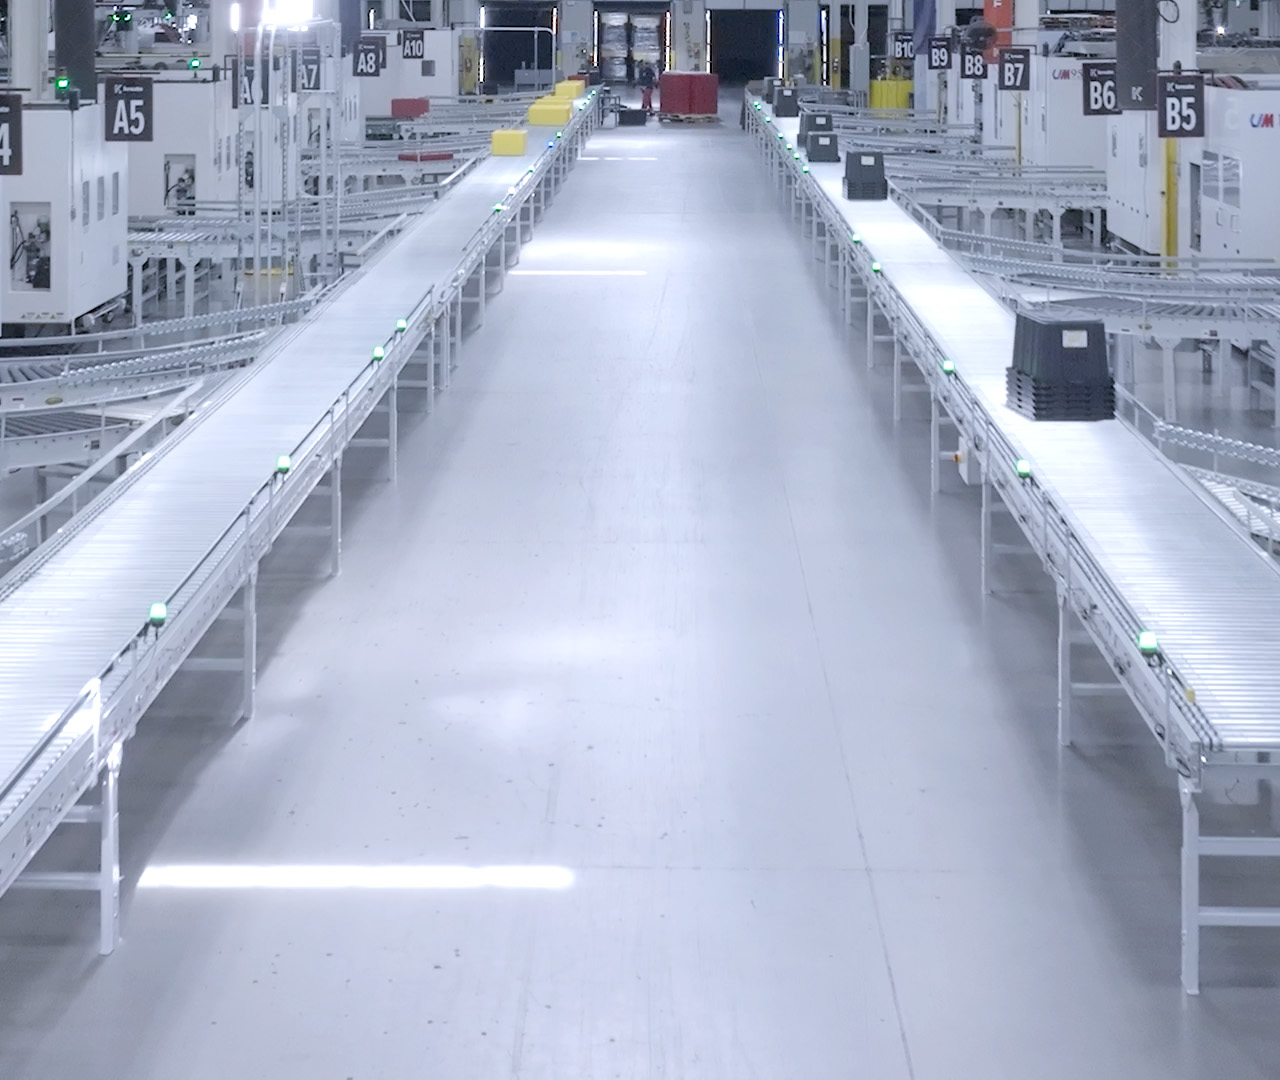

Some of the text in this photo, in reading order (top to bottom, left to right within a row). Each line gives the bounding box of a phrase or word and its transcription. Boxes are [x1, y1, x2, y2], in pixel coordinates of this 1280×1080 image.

[403, 39, 423, 57] A10
[895, 41, 914, 59] B10
[931, 48, 948, 67] B9
[357, 52, 376, 73] A8
[964, 55, 984, 76] B8
[1004, 63, 1025, 87] B7
[1090, 80, 1116, 110] B6
[112, 99, 145, 135] A5
[1165, 97, 1197, 131] B5
